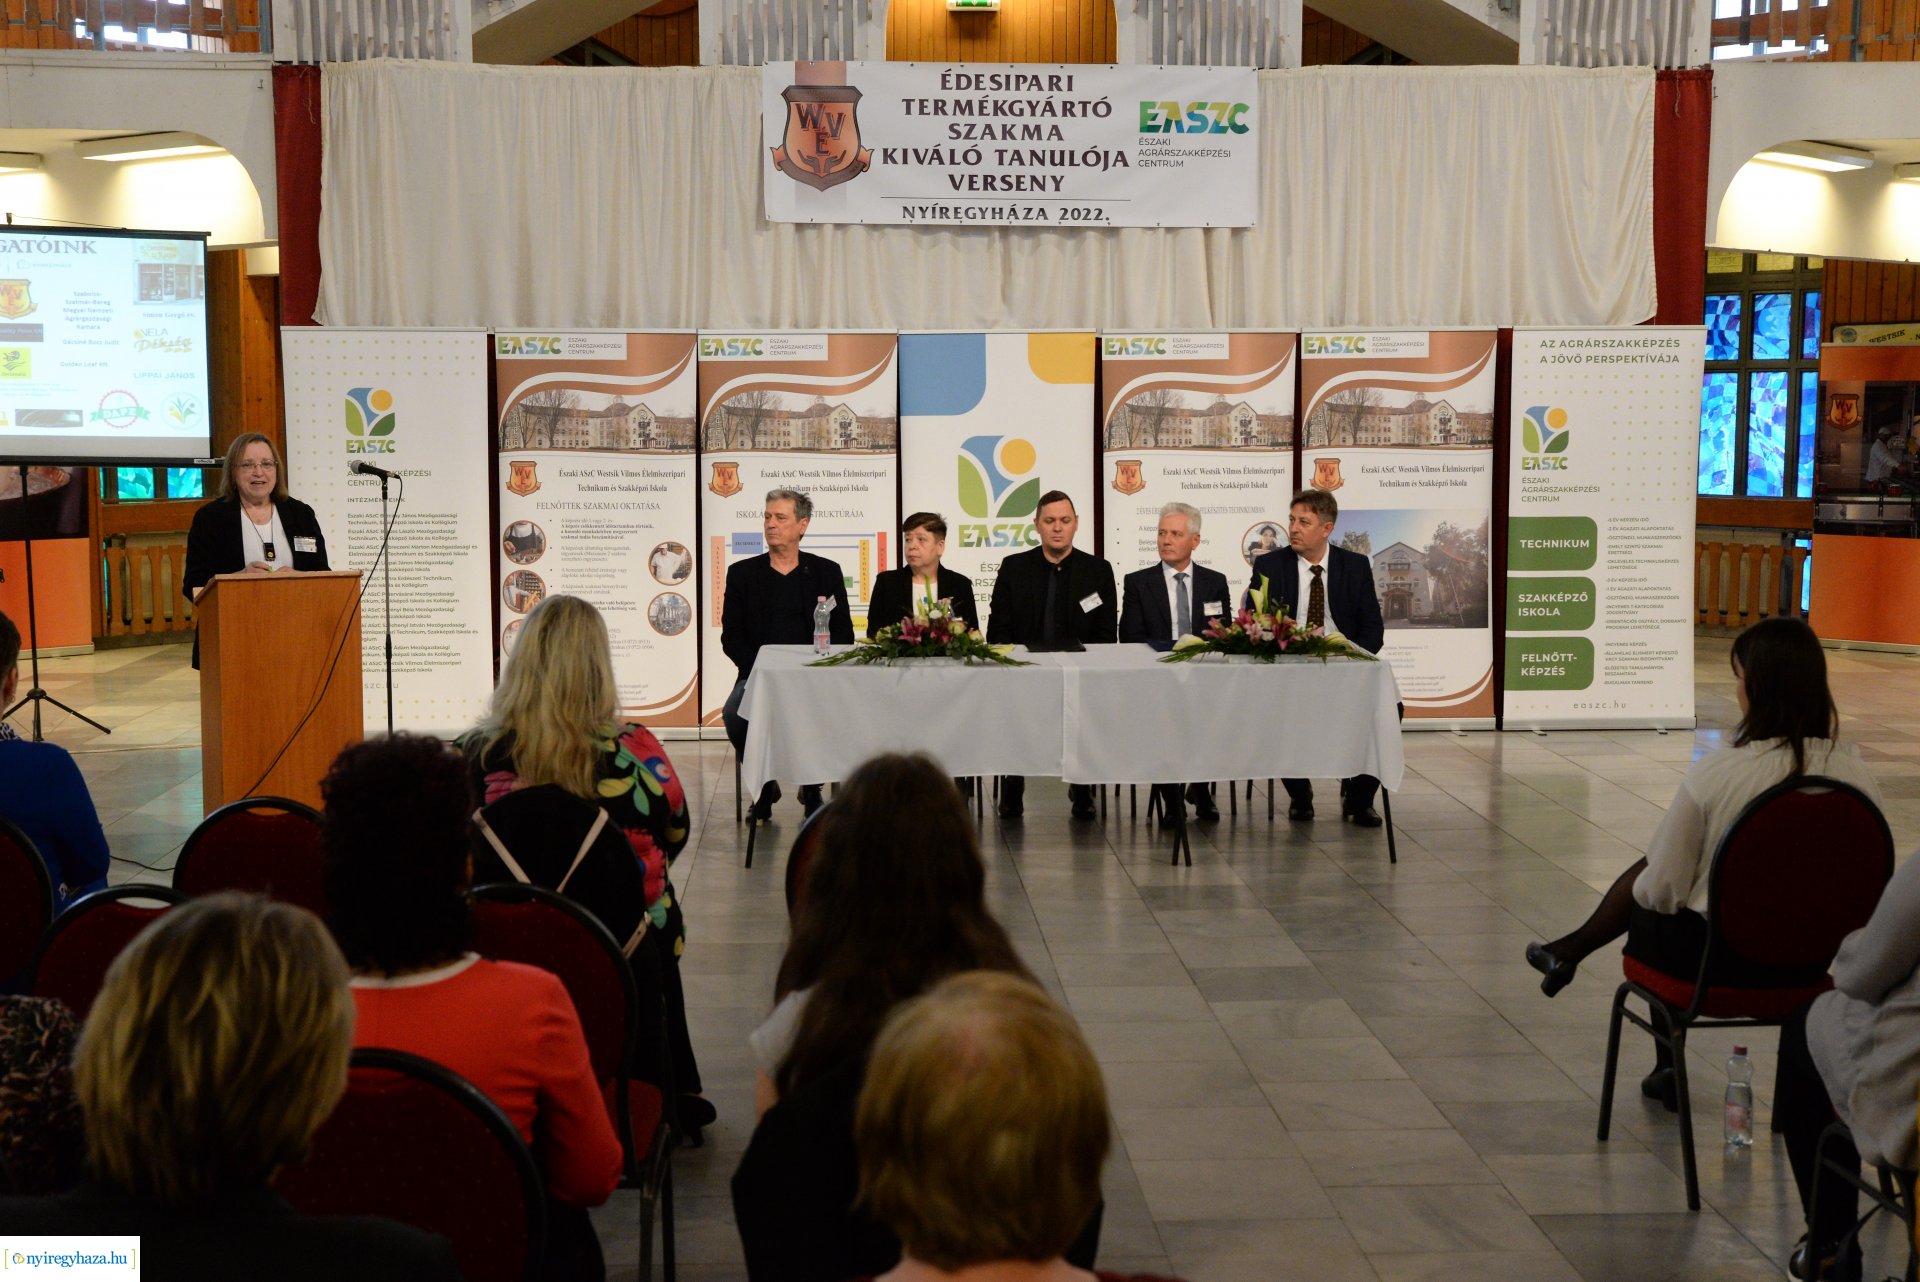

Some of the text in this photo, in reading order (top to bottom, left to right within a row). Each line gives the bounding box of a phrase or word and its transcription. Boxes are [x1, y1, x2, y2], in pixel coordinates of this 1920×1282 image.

[940, 69, 1074, 92] ÉDESIPARI
[902, 95, 1112, 118] TERMÉKGYÁRTÓ
[1140, 101, 1250, 135] EASZC
[948, 122, 1065, 142] SZAKMA
[1139, 137, 1171, 146] ÉSZAKI
[882, 143, 1130, 172] KIVÁLÓ TANULÓJA
[1138, 148, 1231, 158] AGRÁRSZAKKÉPZÉSI
[1139, 160, 1184, 168] CENTRUM
[948, 174, 1065, 192] VERSENY
[902, 202, 1110, 221] NYÍREGYHÁZA 2022.
[498, 336, 562, 355] EASZC
[700, 338, 764, 356] EASZC
[1105, 337, 1166, 356] EASZC
[1304, 336, 1366, 354] EASZC
[1540, 337, 1681, 348] AZ AGRÁRSZAKKÉPZÉS
[1540, 355, 1548, 364] A
[1586, 353, 1680, 364] PERSPEKTÍVÁJA
[346, 440, 396, 454] EASZC
[1361, 464, 1380, 474] Északi
[1398, 465, 1420, 474] Westsik
[1420, 464, 1441, 474] Vilmos
[1522, 457, 1568, 471] EASZC
[559, 468, 579, 479] Északi
[597, 469, 620, 478] Westsik
[621, 469, 641, 478] Vilmos
[760, 468, 780, 479] Északi
[799, 469, 821, 478] Westsik
[822, 469, 842, 478] Vilmos
[1163, 466, 1182, 476] Északi
[1199, 467, 1222, 475] Westsik
[1222, 466, 1242, 475] Vilmos
[1181, 481, 1212, 490] Technikum
[1213, 481, 1220, 490] és
[1250, 481, 1269, 490] Iskola
[1379, 480, 1410, 488] Technikum
[1411, 480, 1418, 488] és
[1450, 479, 1468, 488] Iskola
[1522, 476, 1550, 484] ÉSZAKI
[578, 484, 610, 492] Technikum
[610, 484, 617, 492] és
[650, 484, 667, 492] Iskola
[779, 484, 811, 492] Technikum
[812, 484, 819, 492] és
[851, 484, 869, 492] Iskola
[536, 500, 661, 510] FELNŐTTEK SZAKMAI OKTATÁSA
[959, 524, 1041, 548] EASZC
[1520, 539, 1590, 549] TECHNIKUM
[1518, 592, 1588, 603] SZAKKÉPZŐ
[1518, 607, 1561, 617] ISKOLA
[1521, 652, 1578, 663] FELNŐTT-
[1521, 665, 1566, 676] KÉPZÉS
